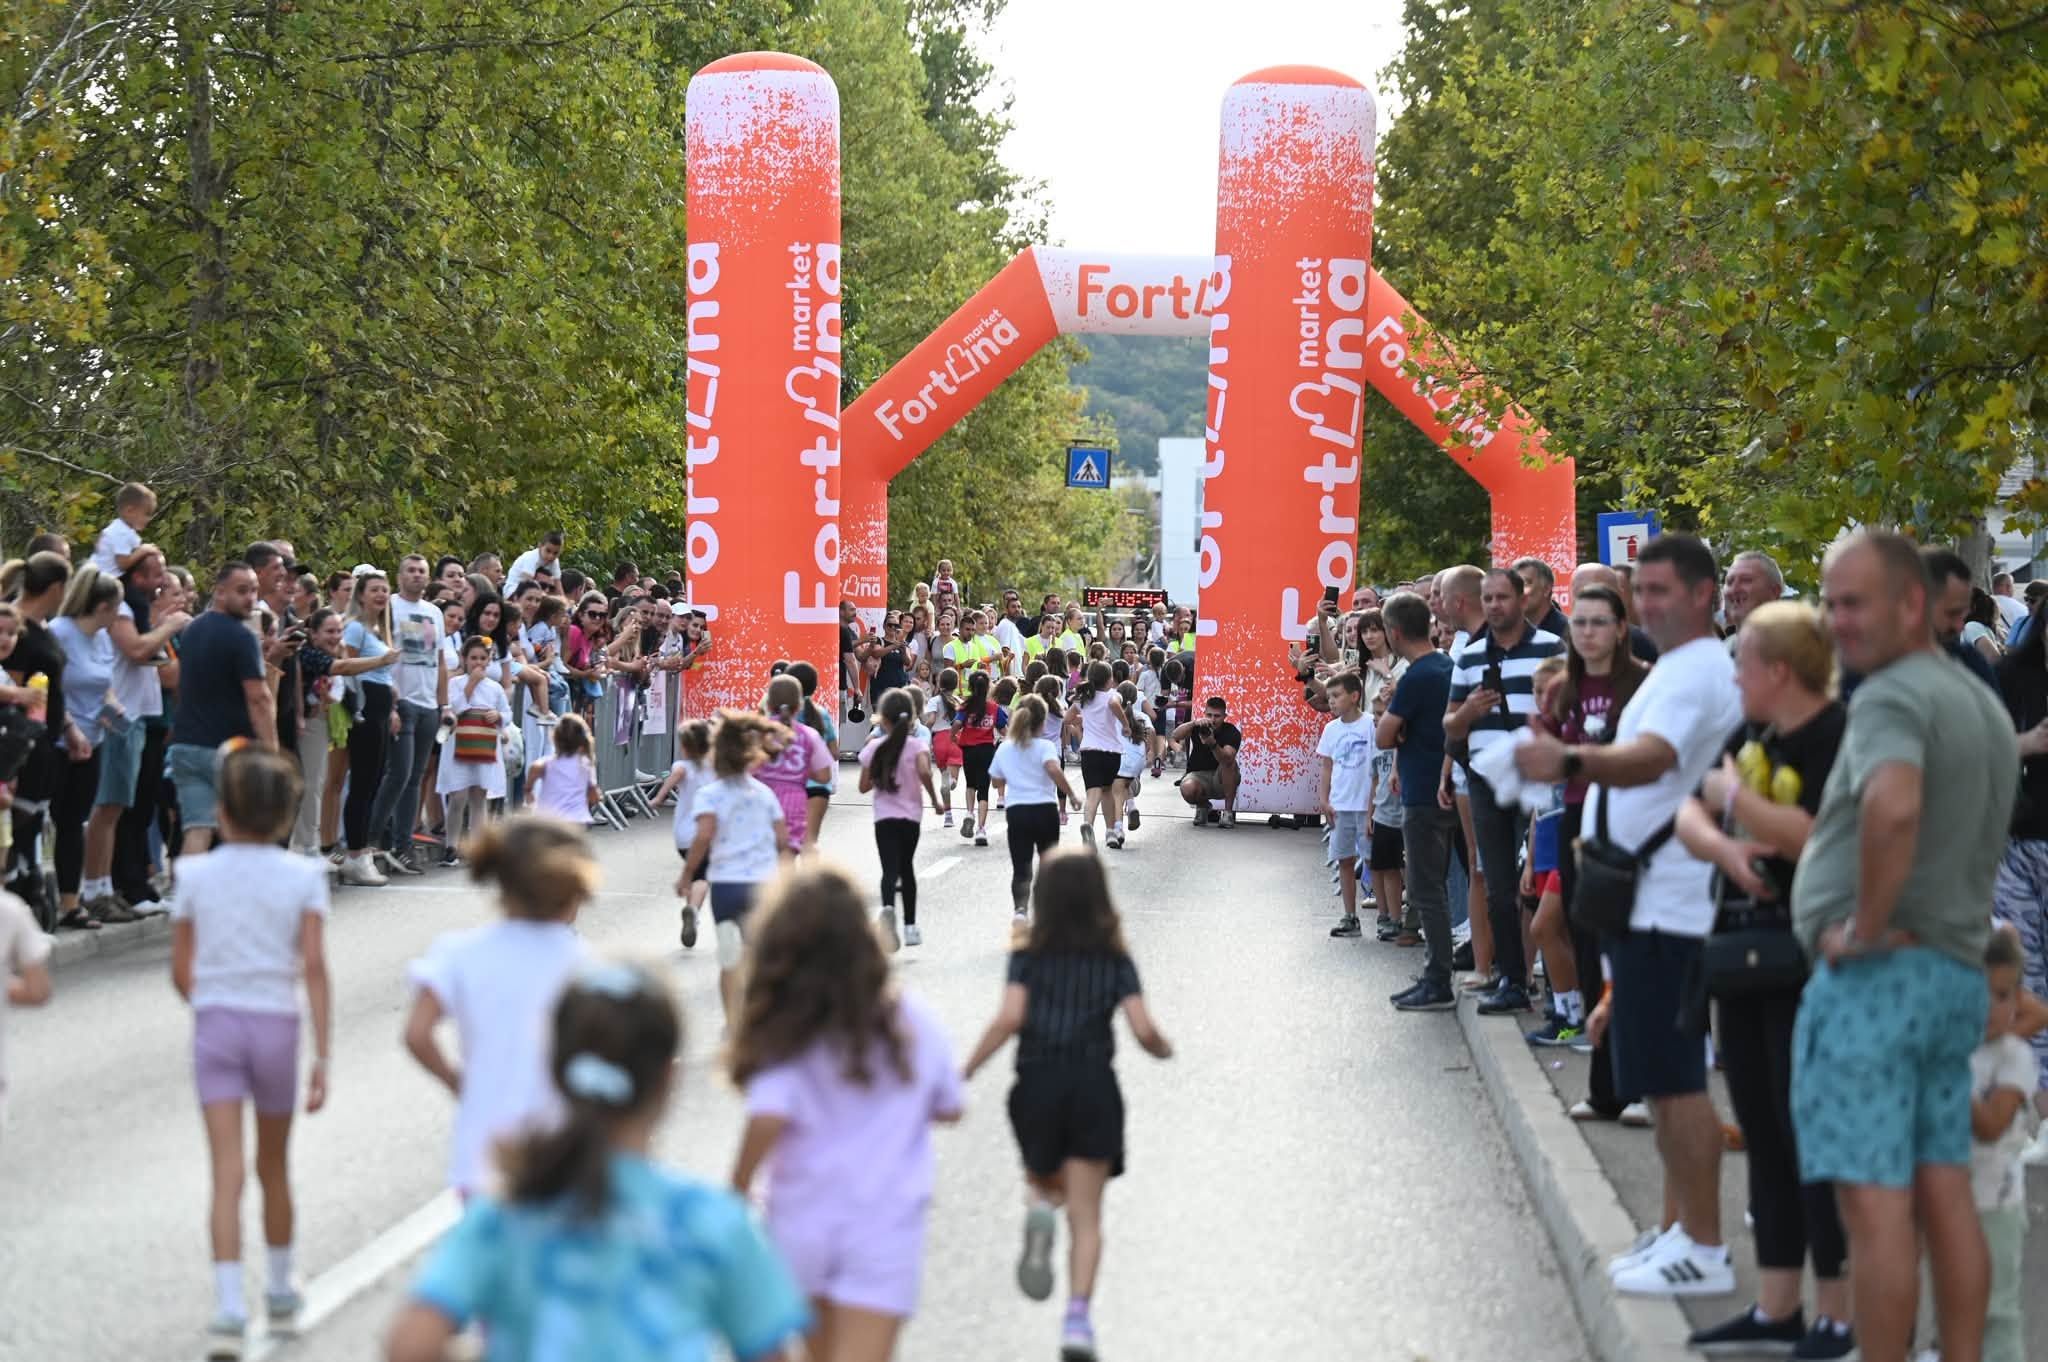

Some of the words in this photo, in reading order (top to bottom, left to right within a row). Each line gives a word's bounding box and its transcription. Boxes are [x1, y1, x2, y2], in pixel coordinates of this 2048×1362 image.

[785, 241, 811, 351] market
[962, 308, 1003, 345] market
[1292, 256, 1323, 367] market
